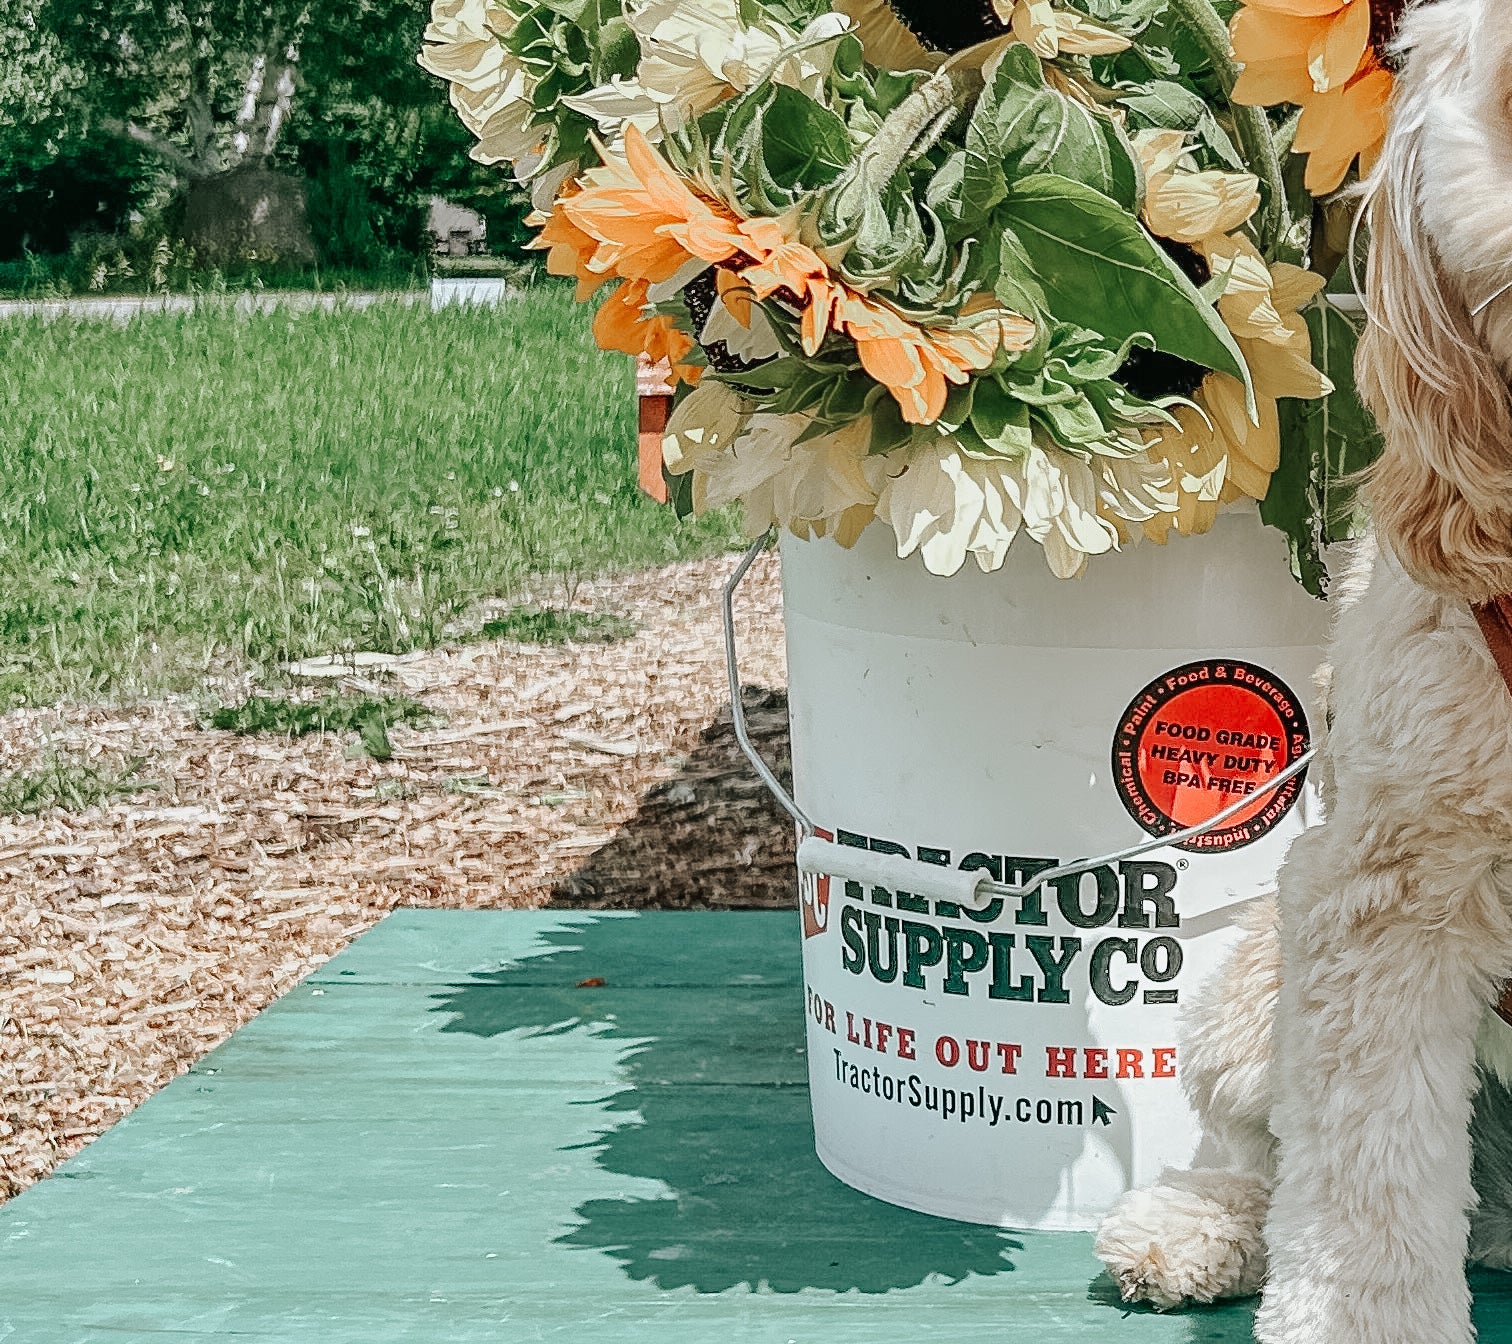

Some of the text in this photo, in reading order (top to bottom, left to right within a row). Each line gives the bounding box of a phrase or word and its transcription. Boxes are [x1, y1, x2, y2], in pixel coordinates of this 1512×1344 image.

[1165, 666, 1210, 691] Food
[1214, 666, 1228, 678] &
[1233, 668, 1294, 718] Beverage
[1122, 694, 1158, 736] Paint
[1154, 720, 1281, 752] FOOD GRADE
[1151, 744, 1276, 774] HEAVY DUTY
[1119, 751, 1157, 826] Chemical
[1163, 770, 1257, 795] BPA FREE
[841, 904, 1082, 1004] SUPPLY
[807, 983, 1177, 1079] FOR LIFE OUT HERE
[833, 1047, 1083, 1127] TractorSupply.com
